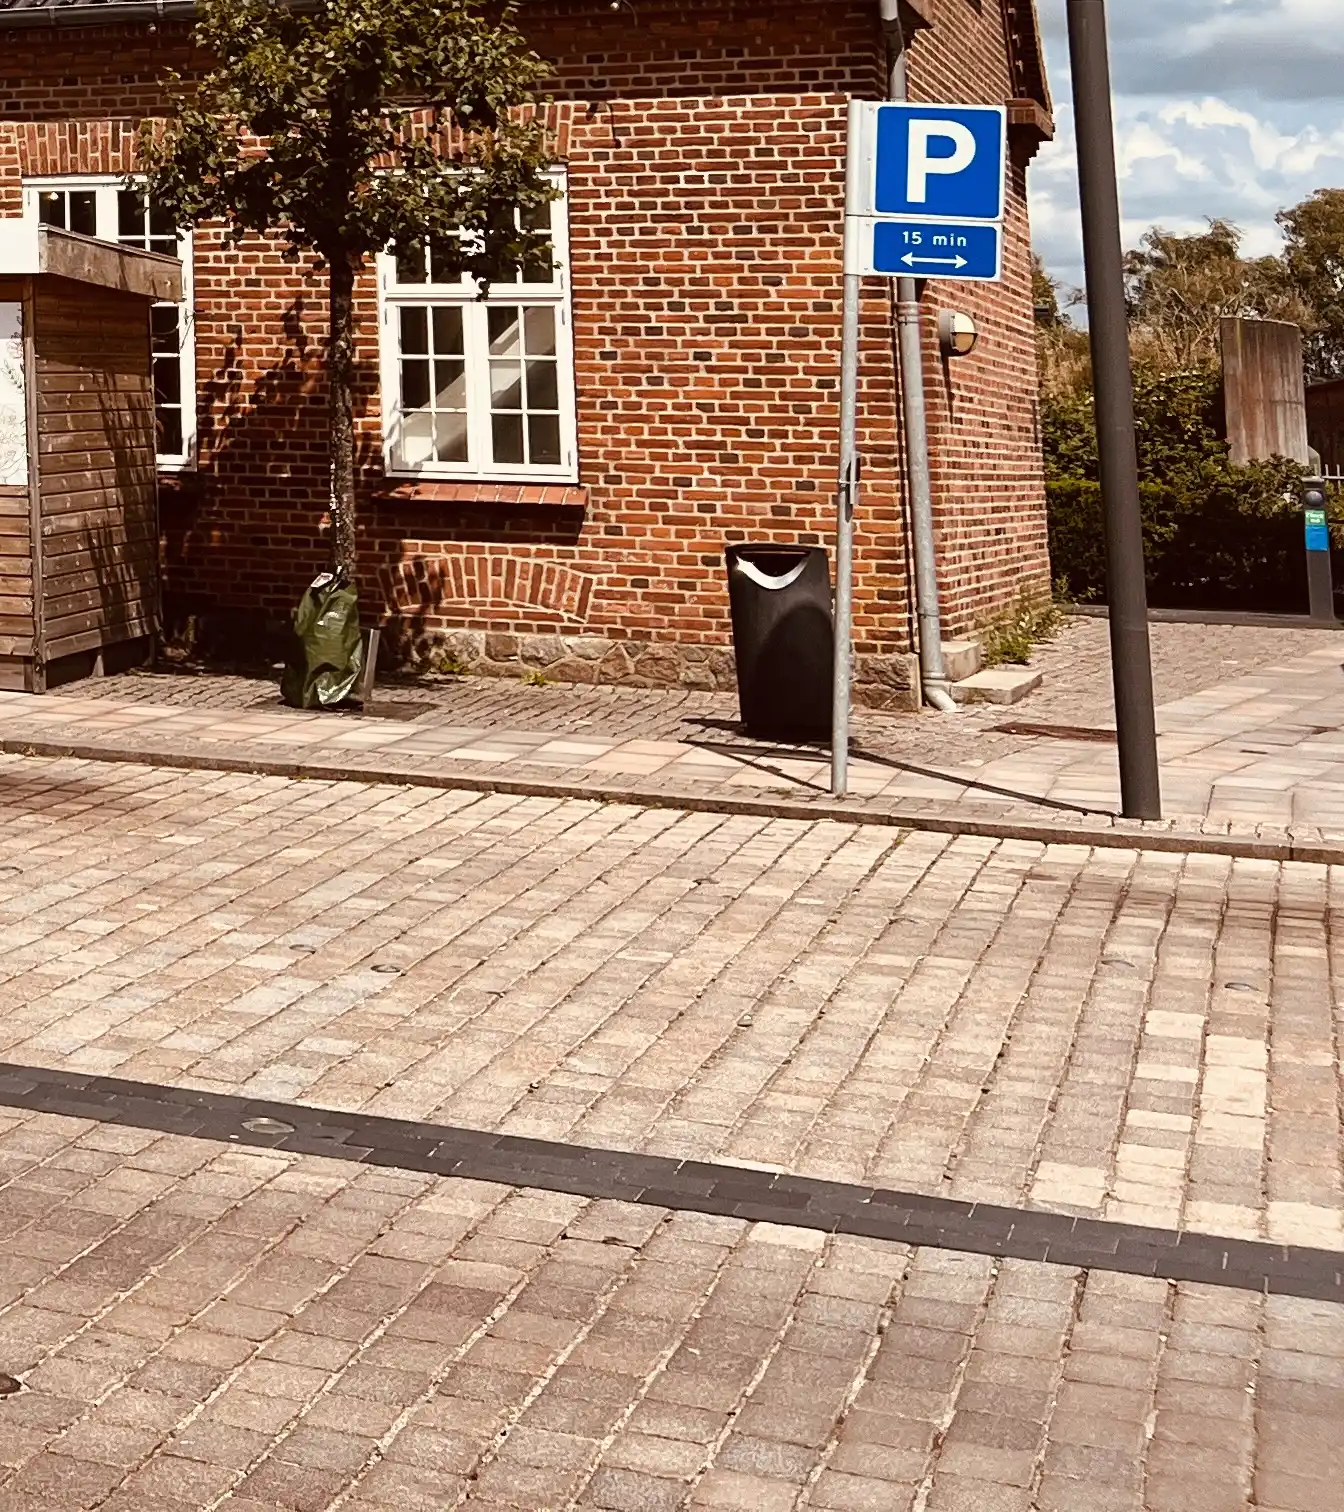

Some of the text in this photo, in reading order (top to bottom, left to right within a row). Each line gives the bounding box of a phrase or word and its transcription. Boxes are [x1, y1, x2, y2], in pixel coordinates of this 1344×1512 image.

[906, 118, 976, 203] P
[902, 230, 967, 247] 15 min
